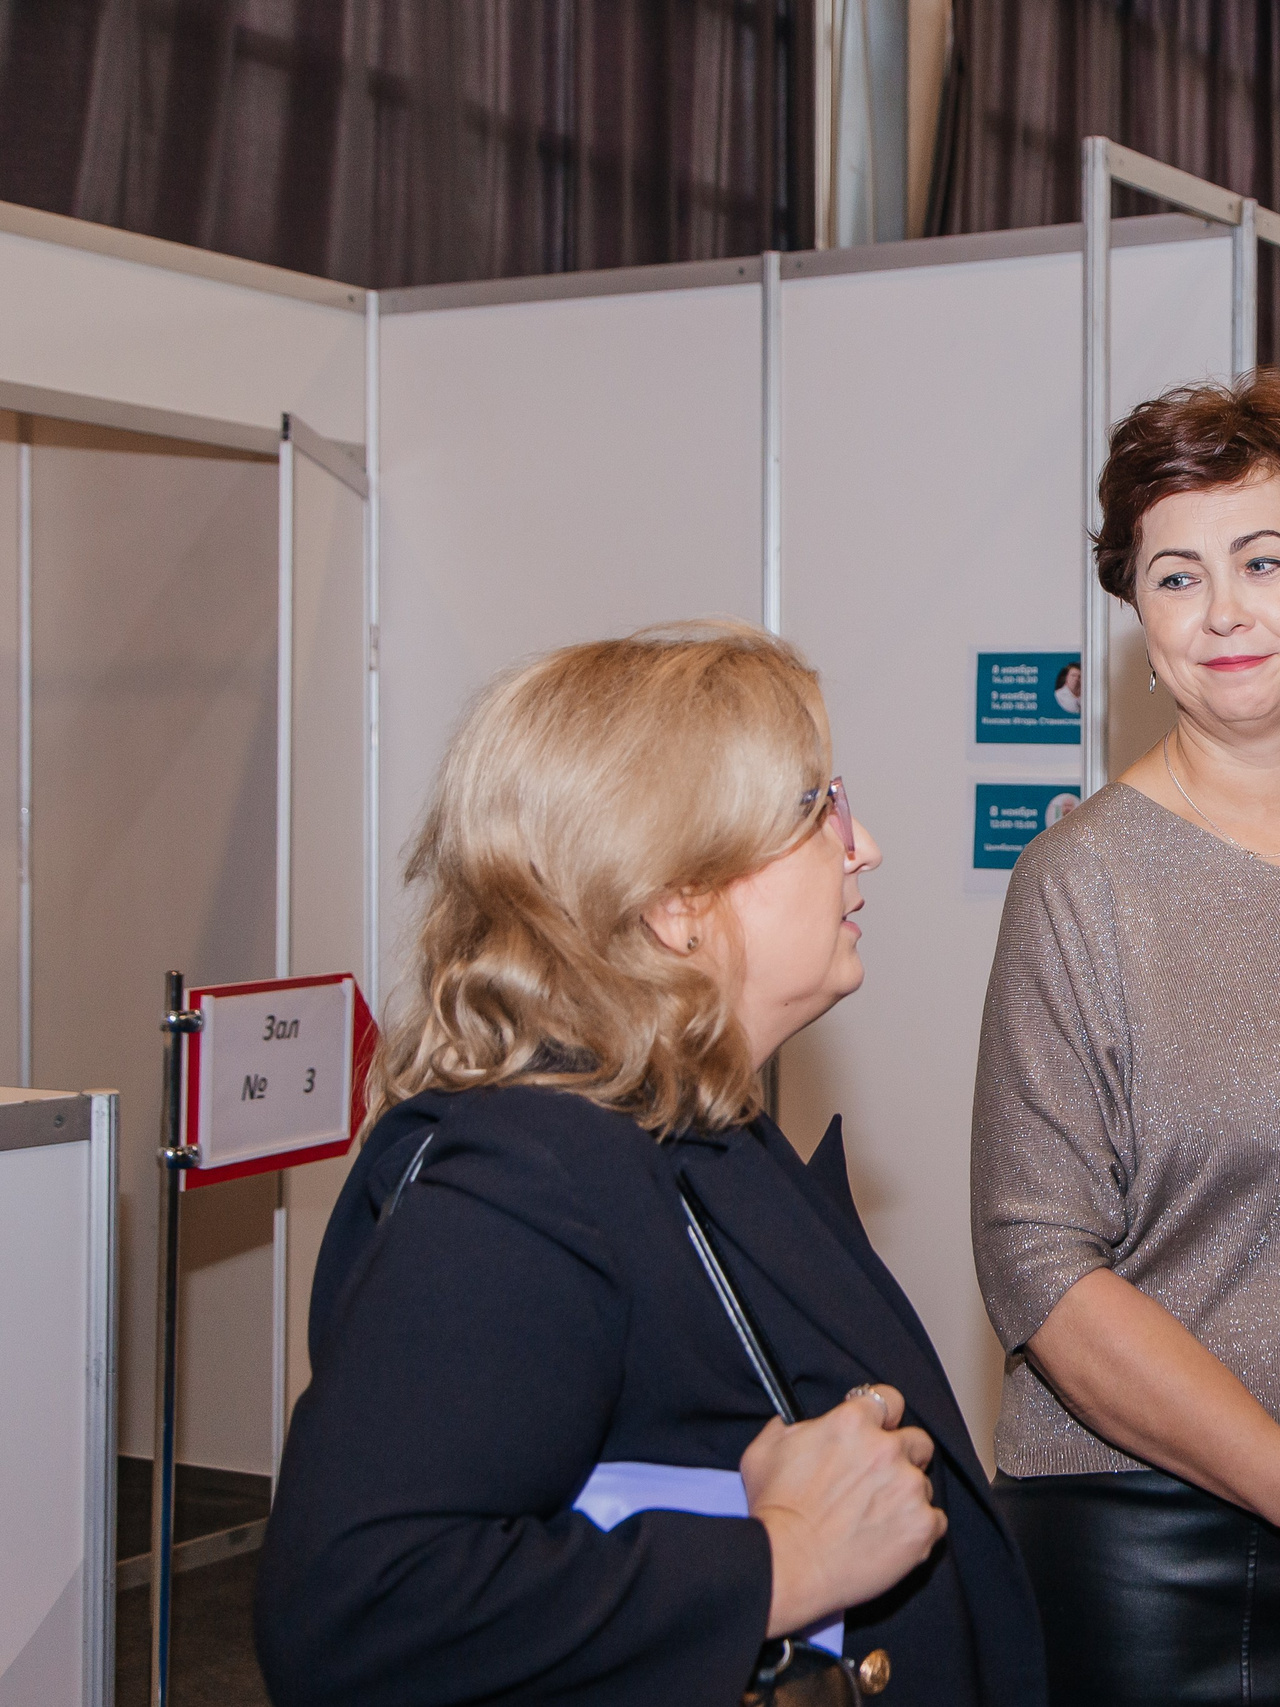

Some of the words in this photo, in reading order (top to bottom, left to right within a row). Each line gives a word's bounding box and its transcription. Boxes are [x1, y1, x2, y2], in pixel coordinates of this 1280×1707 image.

[263, 1014, 299, 1041] Зал
[241, 1073, 269, 1101] №
[303, 1067, 316, 1093] 3
